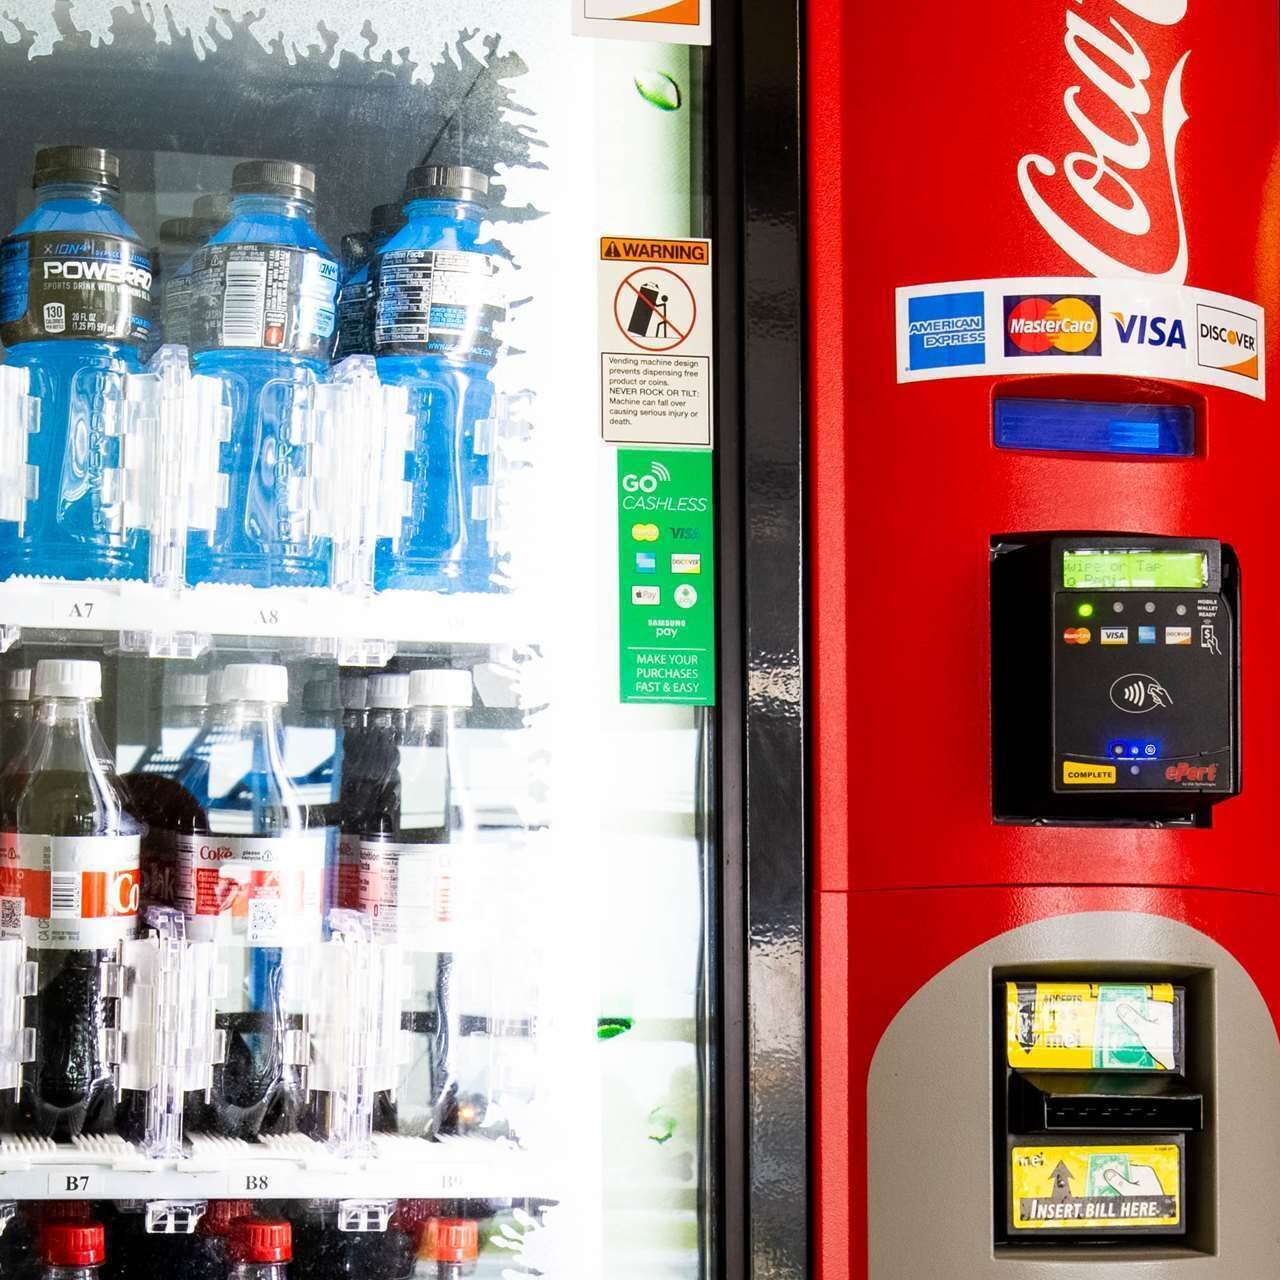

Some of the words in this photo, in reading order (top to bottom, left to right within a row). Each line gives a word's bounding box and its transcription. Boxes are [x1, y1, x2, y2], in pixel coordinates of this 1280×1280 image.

[1017, 0, 1192, 285] Coca
[622, 243, 705, 261] WARNING
[46, 306, 63, 319] 130
[909, 316, 981, 334] AMERICAN
[1010, 316, 1095, 334] MasterCard
[1109, 312, 1187, 349] VISA
[924, 332, 986, 347] EXPRESS
[1200, 323, 1255, 351] DISCOVER
[609, 357, 639, 366] Vending
[640, 358, 672, 367] machine
[674, 359, 699, 368] design
[609, 368, 641, 376] prevents
[642, 369, 683, 377] dispensing
[684, 369, 699, 377] free
[609, 378, 638, 386] product
[609, 387, 638, 395] NEVER
[639, 388, 664, 396] ROCK
[609, 397, 640, 406] Machine
[657, 398, 669, 406] fall
[609, 408, 638, 417] causing
[639, 409, 667, 417] serious
[668, 410, 689, 418] injury
[609, 417, 632, 425] death.
[622, 474, 658, 493] GO
[622, 496, 707, 512] CASHLESS
[670, 527, 700, 539] VISA
[69, 603, 94, 618] A7
[648, 619, 686, 627] SAMSUNG
[656, 627, 678, 639] pay
[1105, 631, 1125, 639] VISA
[636, 655, 667, 664] MAKE
[668, 655, 698, 665] YOUR
[636, 668, 698, 679] PURCHASES
[636, 682, 660, 692] FAST
[662, 683, 671, 692] &
[673, 683, 700, 693] EASY
[1068, 771, 1112, 779] COMPLETE
[1165, 762, 1218, 781] ePort
[65, 1175, 89, 1191] B7
[246, 1175, 268, 1190] B8
[1031, 1200, 1081, 1219] INSERT
[1085, 1201, 1116, 1217] BILL
[1120, 1201, 1158, 1217] HERE
